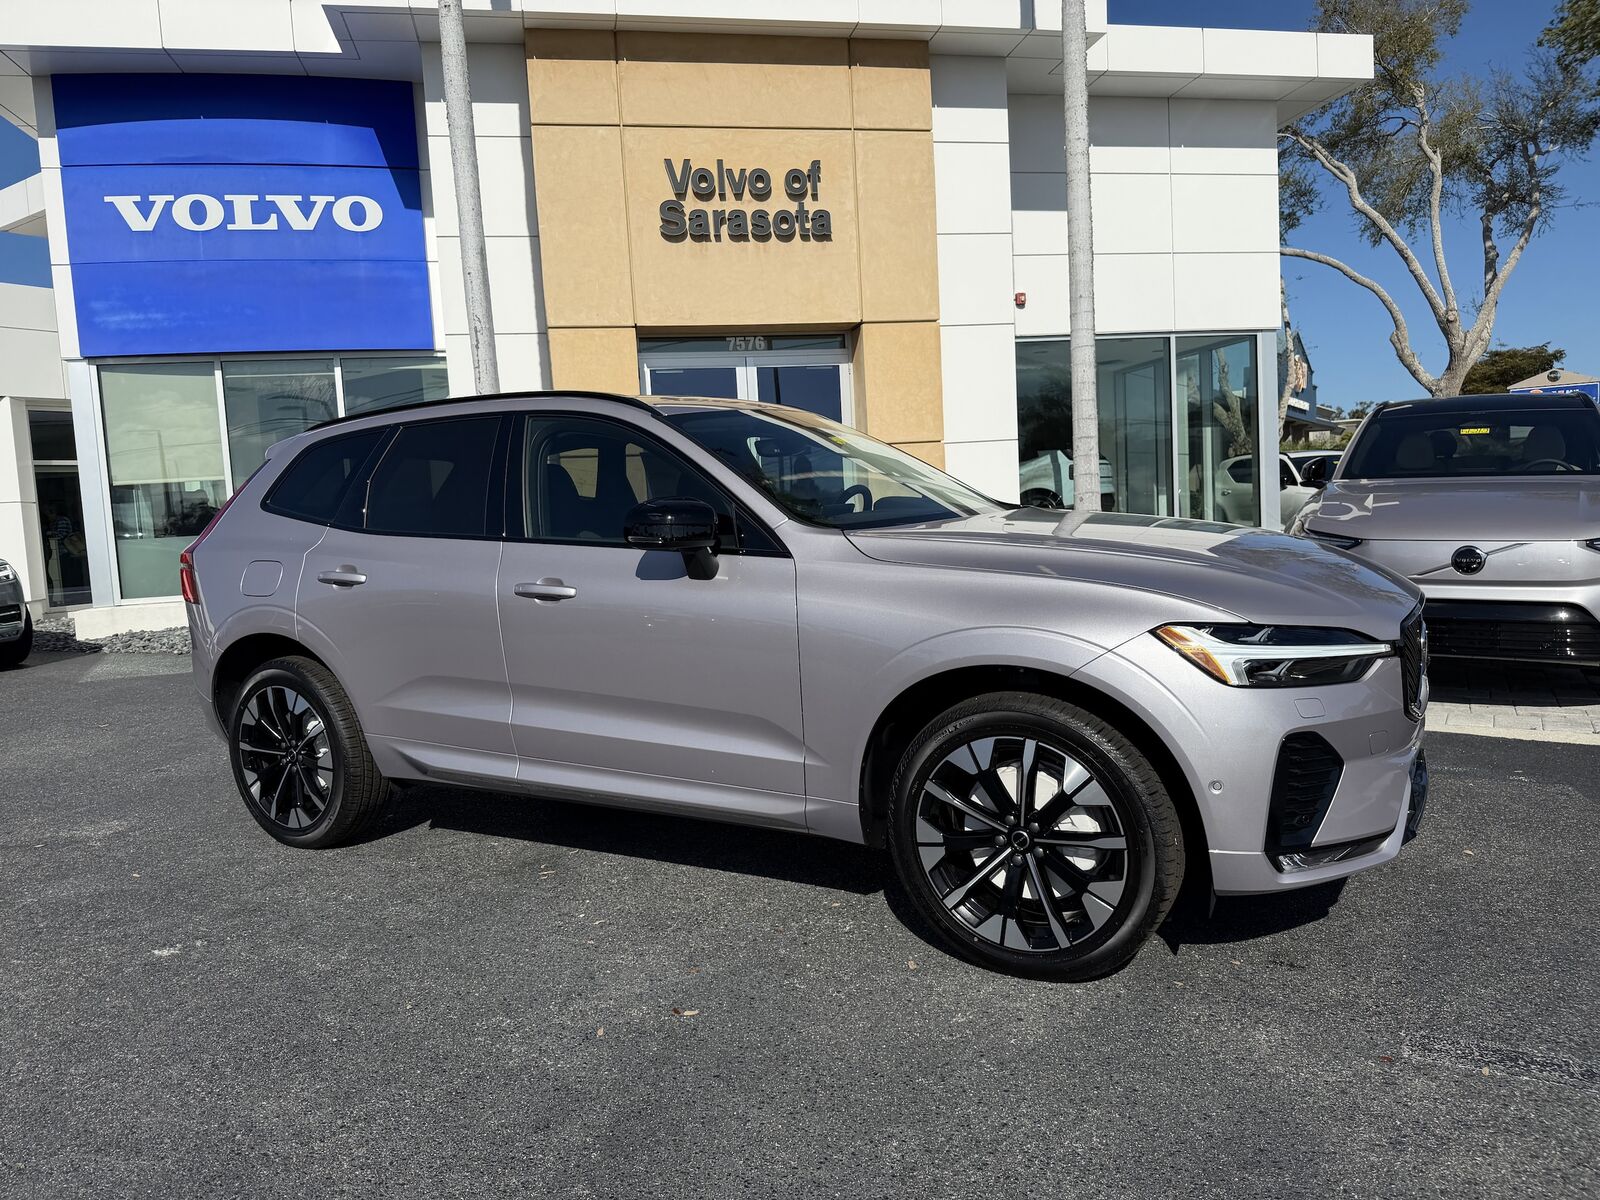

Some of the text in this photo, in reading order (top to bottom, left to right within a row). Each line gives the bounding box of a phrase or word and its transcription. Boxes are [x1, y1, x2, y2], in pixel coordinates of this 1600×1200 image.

[664, 158, 822, 201] Volvo of
[104, 193, 383, 232] VOLVO
[659, 200, 833, 242] Sarasota
[726, 336, 765, 351] 7576
